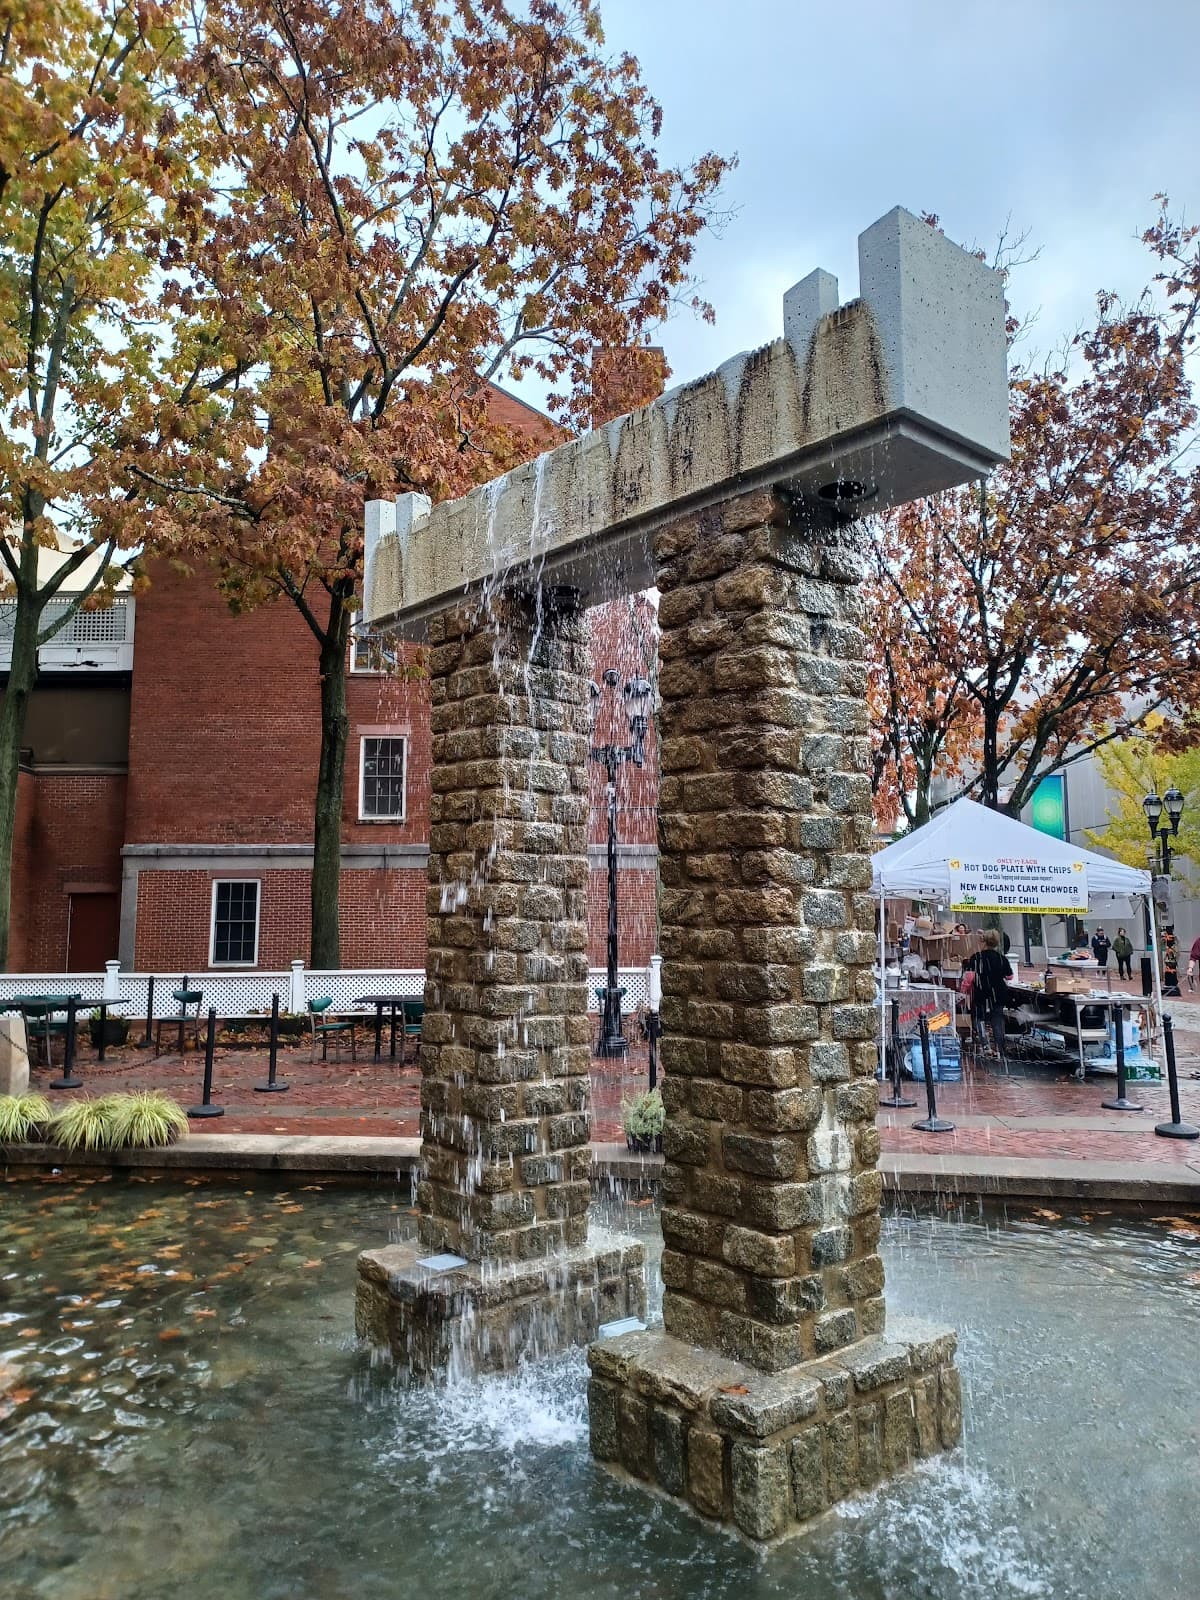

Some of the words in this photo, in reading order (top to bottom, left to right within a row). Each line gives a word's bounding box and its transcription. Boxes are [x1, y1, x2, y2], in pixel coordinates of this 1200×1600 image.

[964, 863, 980, 872] HOT
[982, 864, 998, 872] DOG
[1000, 864, 1024, 873] PLATE
[1026, 864, 1046, 874] WITH
[1048, 865, 1072, 874] CHIPS
[960, 882, 977, 891] NEW
[979, 883, 1015, 892] ENGLAND
[1017, 884, 1038, 893] CLAM
[1040, 885, 1079, 894] CHOWDER
[997, 895, 1017, 904] BEEF
[1018, 896, 1039, 904] CHILI
